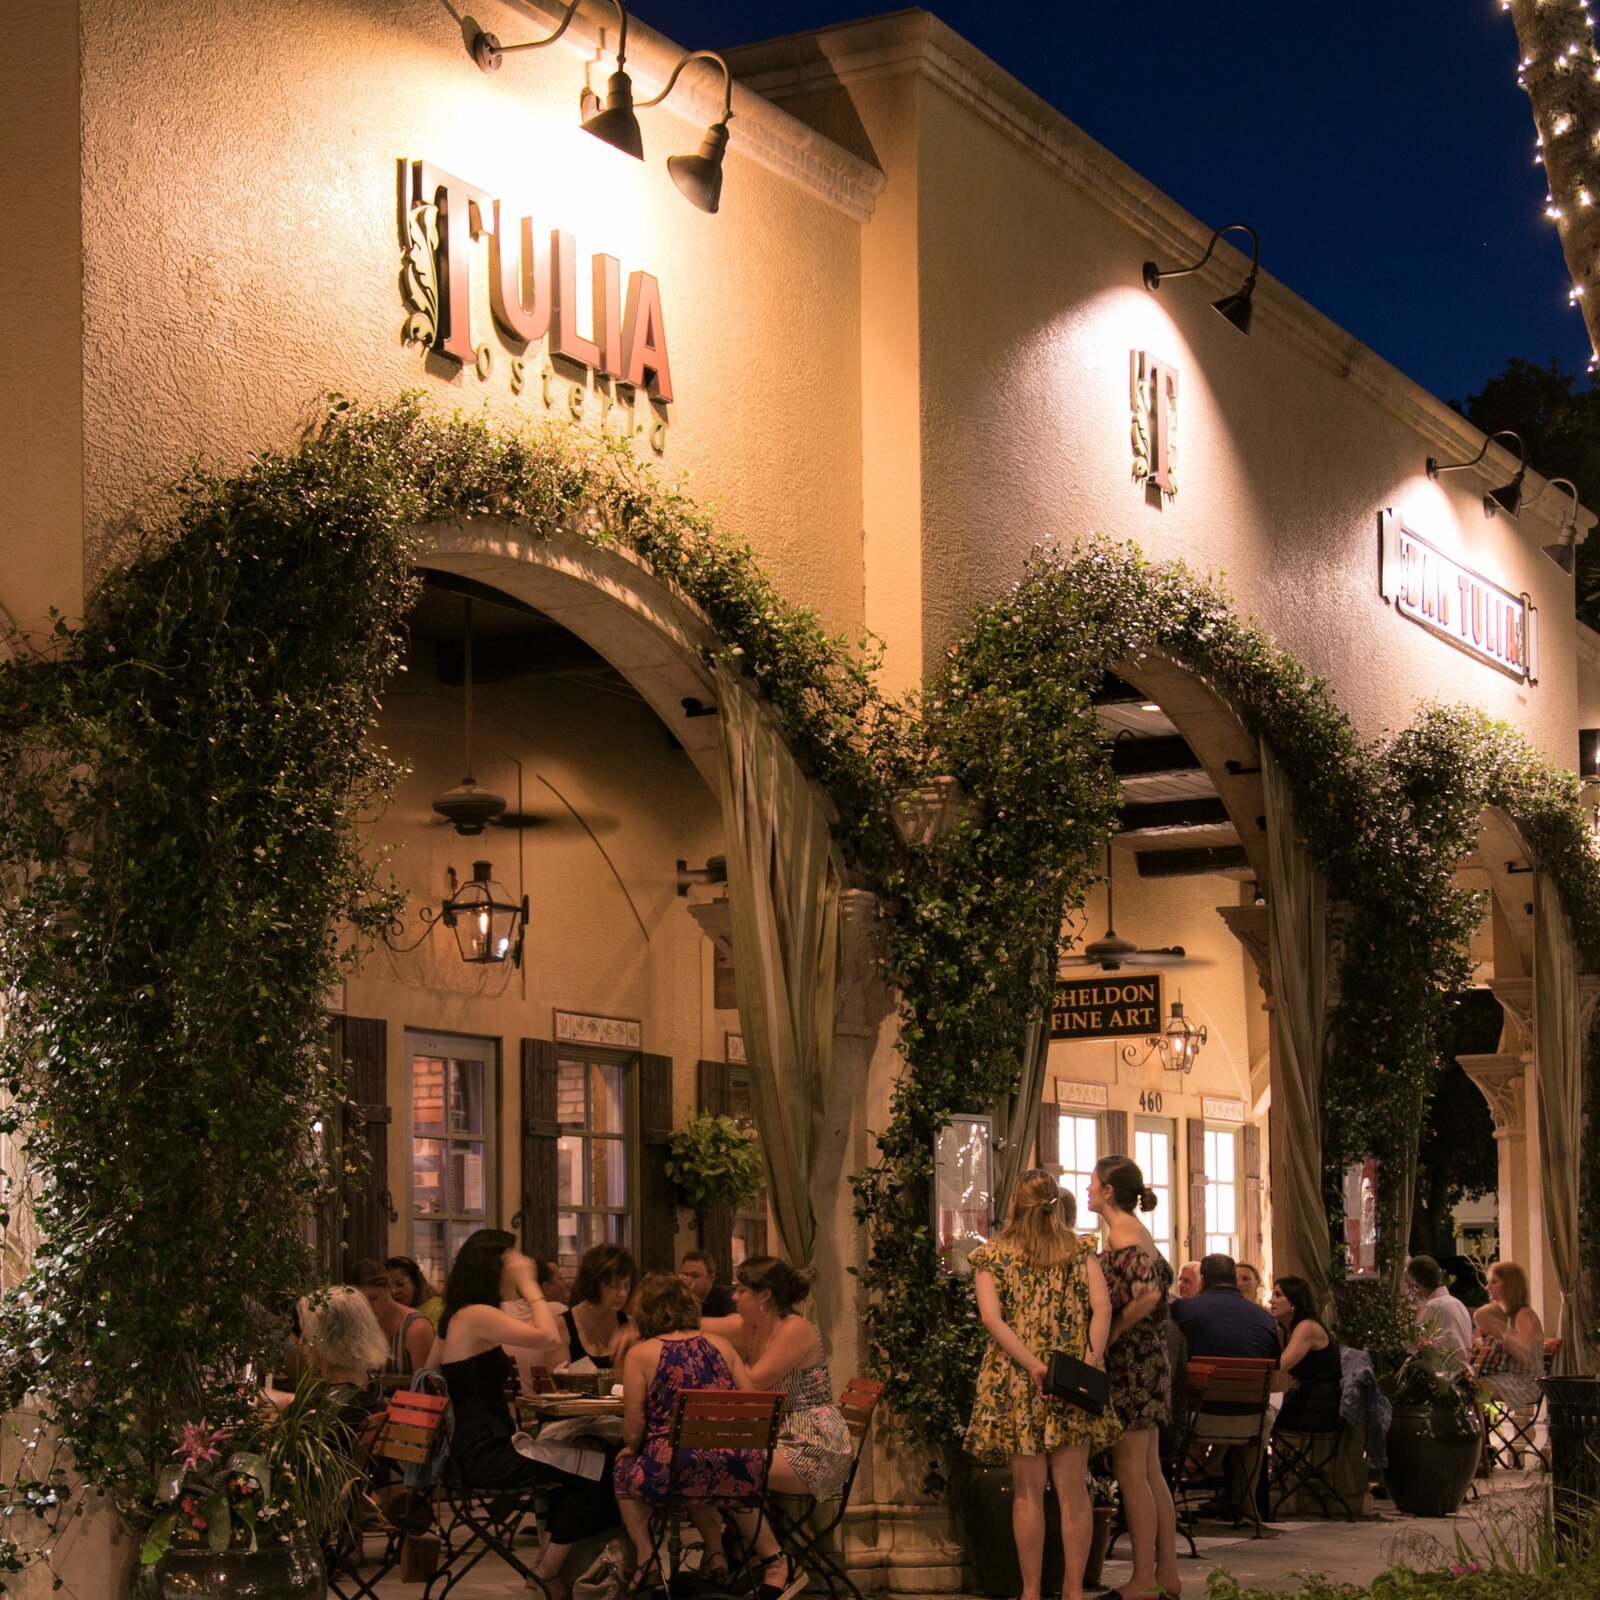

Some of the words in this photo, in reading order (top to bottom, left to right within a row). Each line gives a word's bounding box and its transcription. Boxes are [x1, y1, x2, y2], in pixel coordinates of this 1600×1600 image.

[412, 160, 674, 404] TULIA
[1458, 575, 1518, 665] TULIA
[1051, 1010, 1103, 1031] FINE
[1108, 1007, 1155, 1028] ART
[1138, 1089, 1163, 1113] 460
